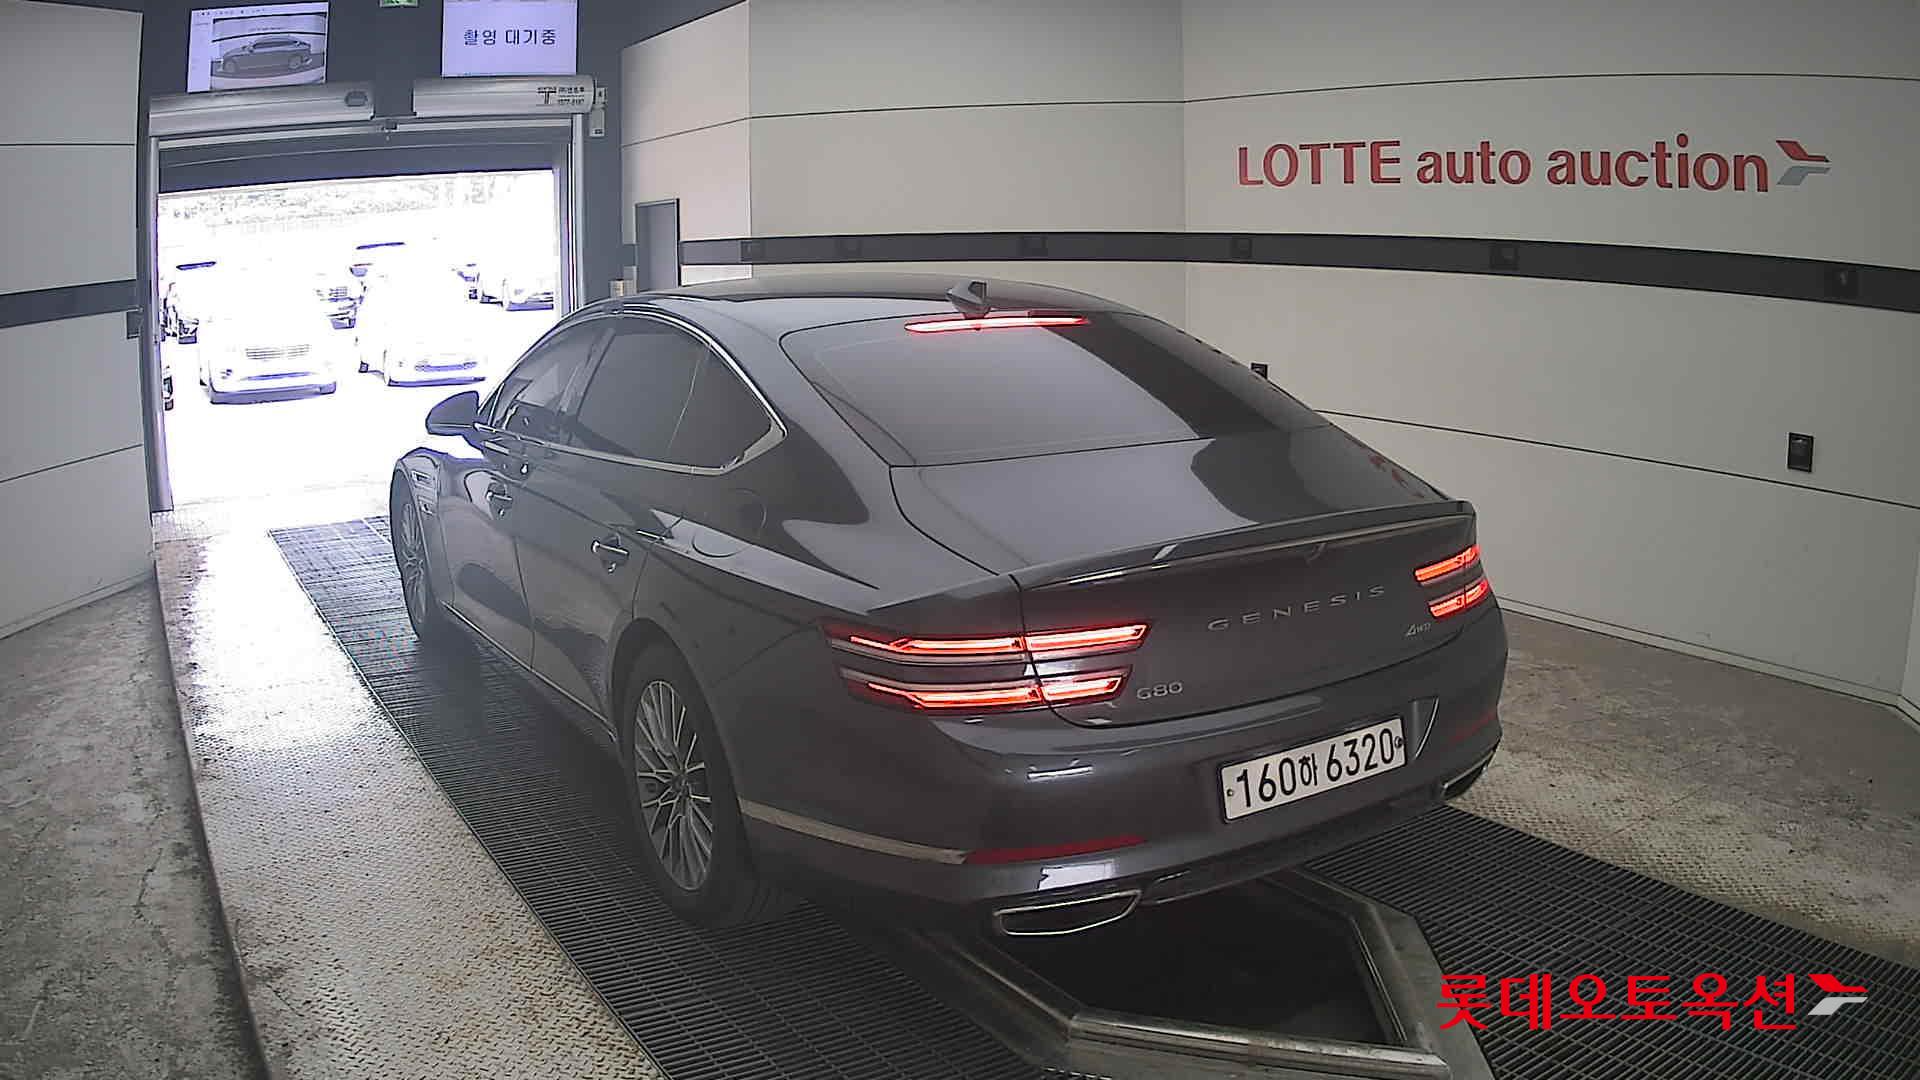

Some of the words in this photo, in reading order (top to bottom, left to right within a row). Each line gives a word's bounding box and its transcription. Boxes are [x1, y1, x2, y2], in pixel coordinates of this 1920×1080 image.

[464, 29, 497, 46] 촬영
[505, 29, 556, 46] 대기중
[1238, 141, 1401, 187] LOTTE
[1416, 141, 1530, 184] auto
[1546, 134, 1768, 192] auction
[1208, 585, 1385, 631] GENESIS
[1136, 681, 1183, 700] G80
